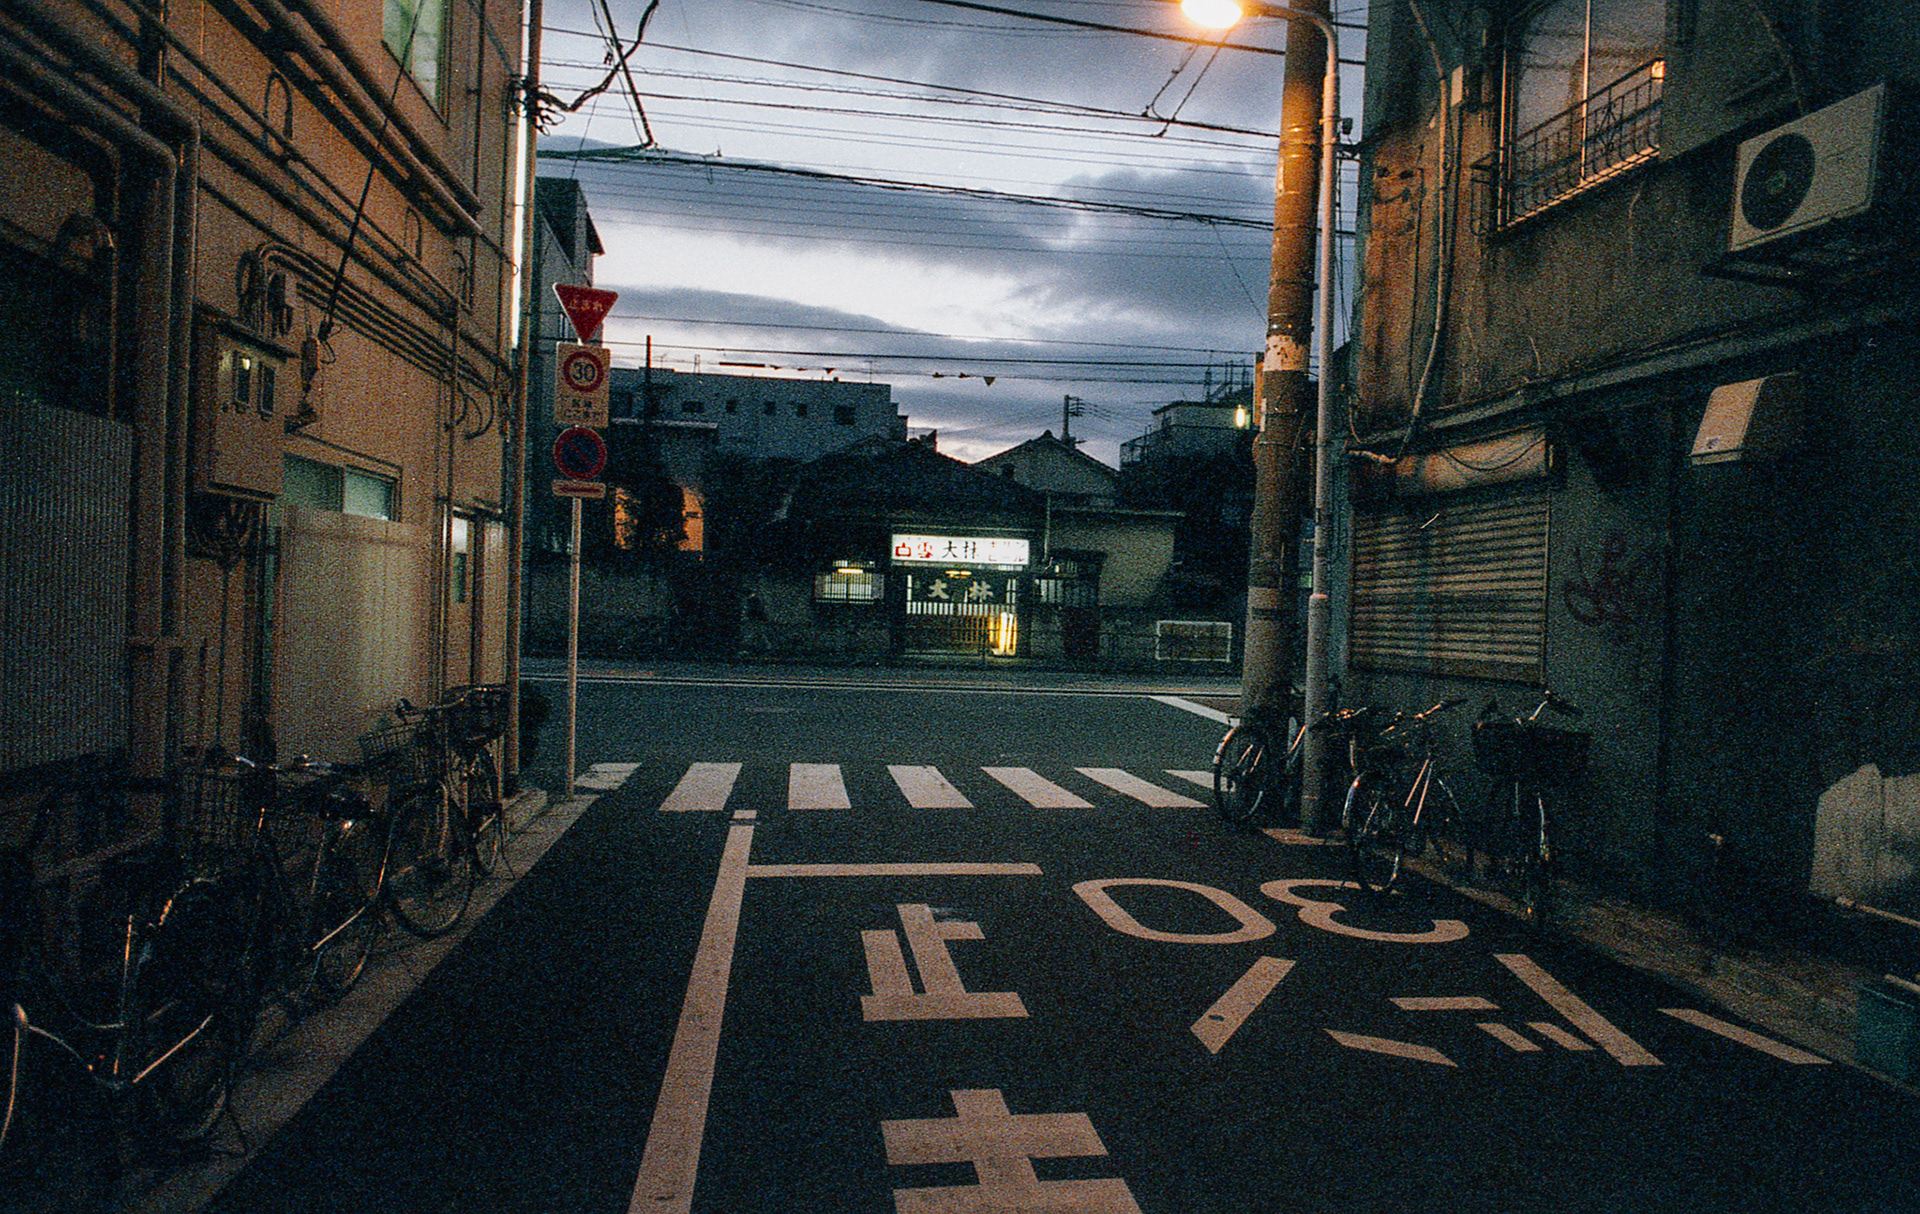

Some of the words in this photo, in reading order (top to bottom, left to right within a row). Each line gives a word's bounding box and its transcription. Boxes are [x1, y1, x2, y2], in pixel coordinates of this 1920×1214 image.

[572, 362, 596, 381] 30
[942, 540, 979, 559] 大林
[928, 579, 994, 600] 大林
[1071, 878, 1471, 944] 30
